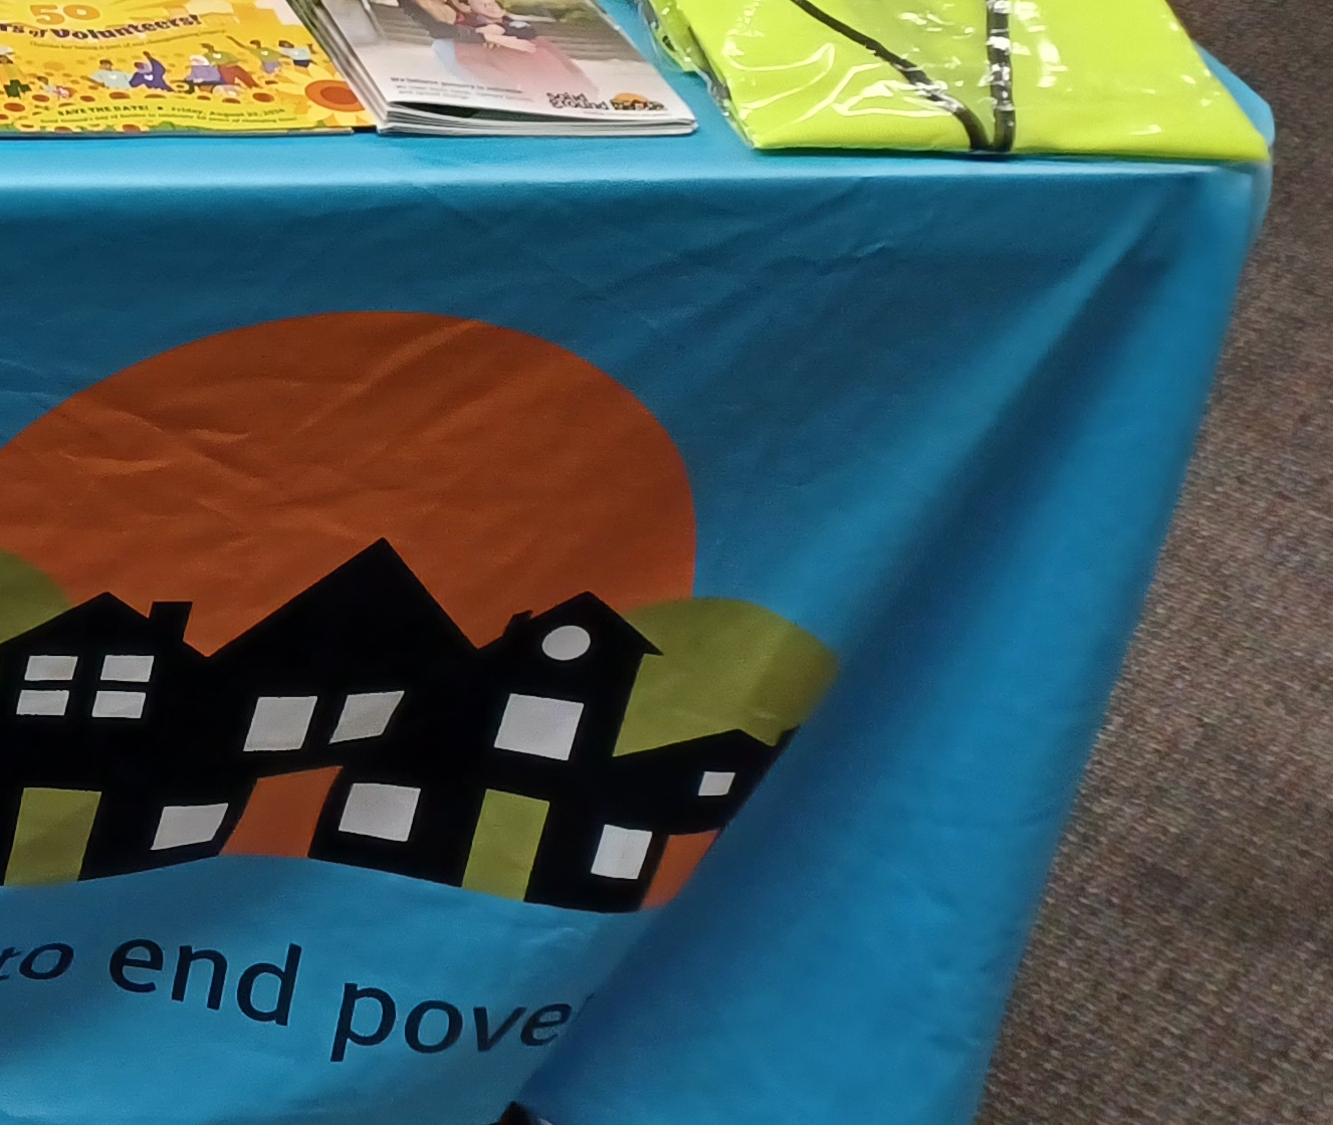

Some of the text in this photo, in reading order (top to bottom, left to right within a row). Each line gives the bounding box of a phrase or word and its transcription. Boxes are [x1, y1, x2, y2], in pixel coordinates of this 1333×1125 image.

[30, 4, 100, 25] 50
[50, 14, 202, 40] Volunteers!
[108, 935, 303, 1028] end
[329, 981, 579, 1063] pove
